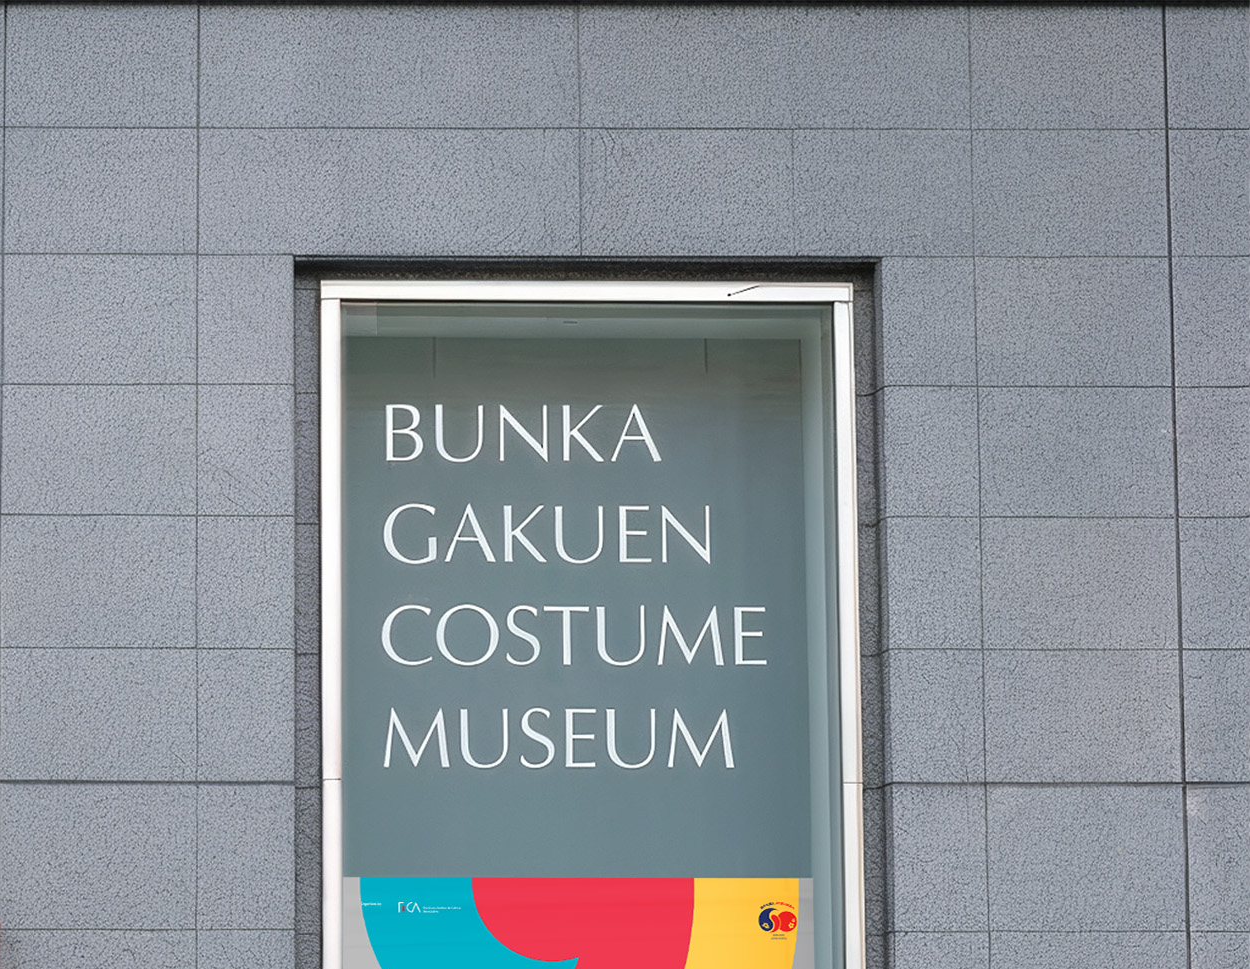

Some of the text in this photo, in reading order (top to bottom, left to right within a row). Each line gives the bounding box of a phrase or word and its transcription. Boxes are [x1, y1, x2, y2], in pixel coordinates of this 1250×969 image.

[384, 402, 663, 463] BUNKA
[382, 502, 712, 566] GAKUEN
[380, 603, 768, 667] COSTUME
[382, 706, 736, 770] MUSEUM
